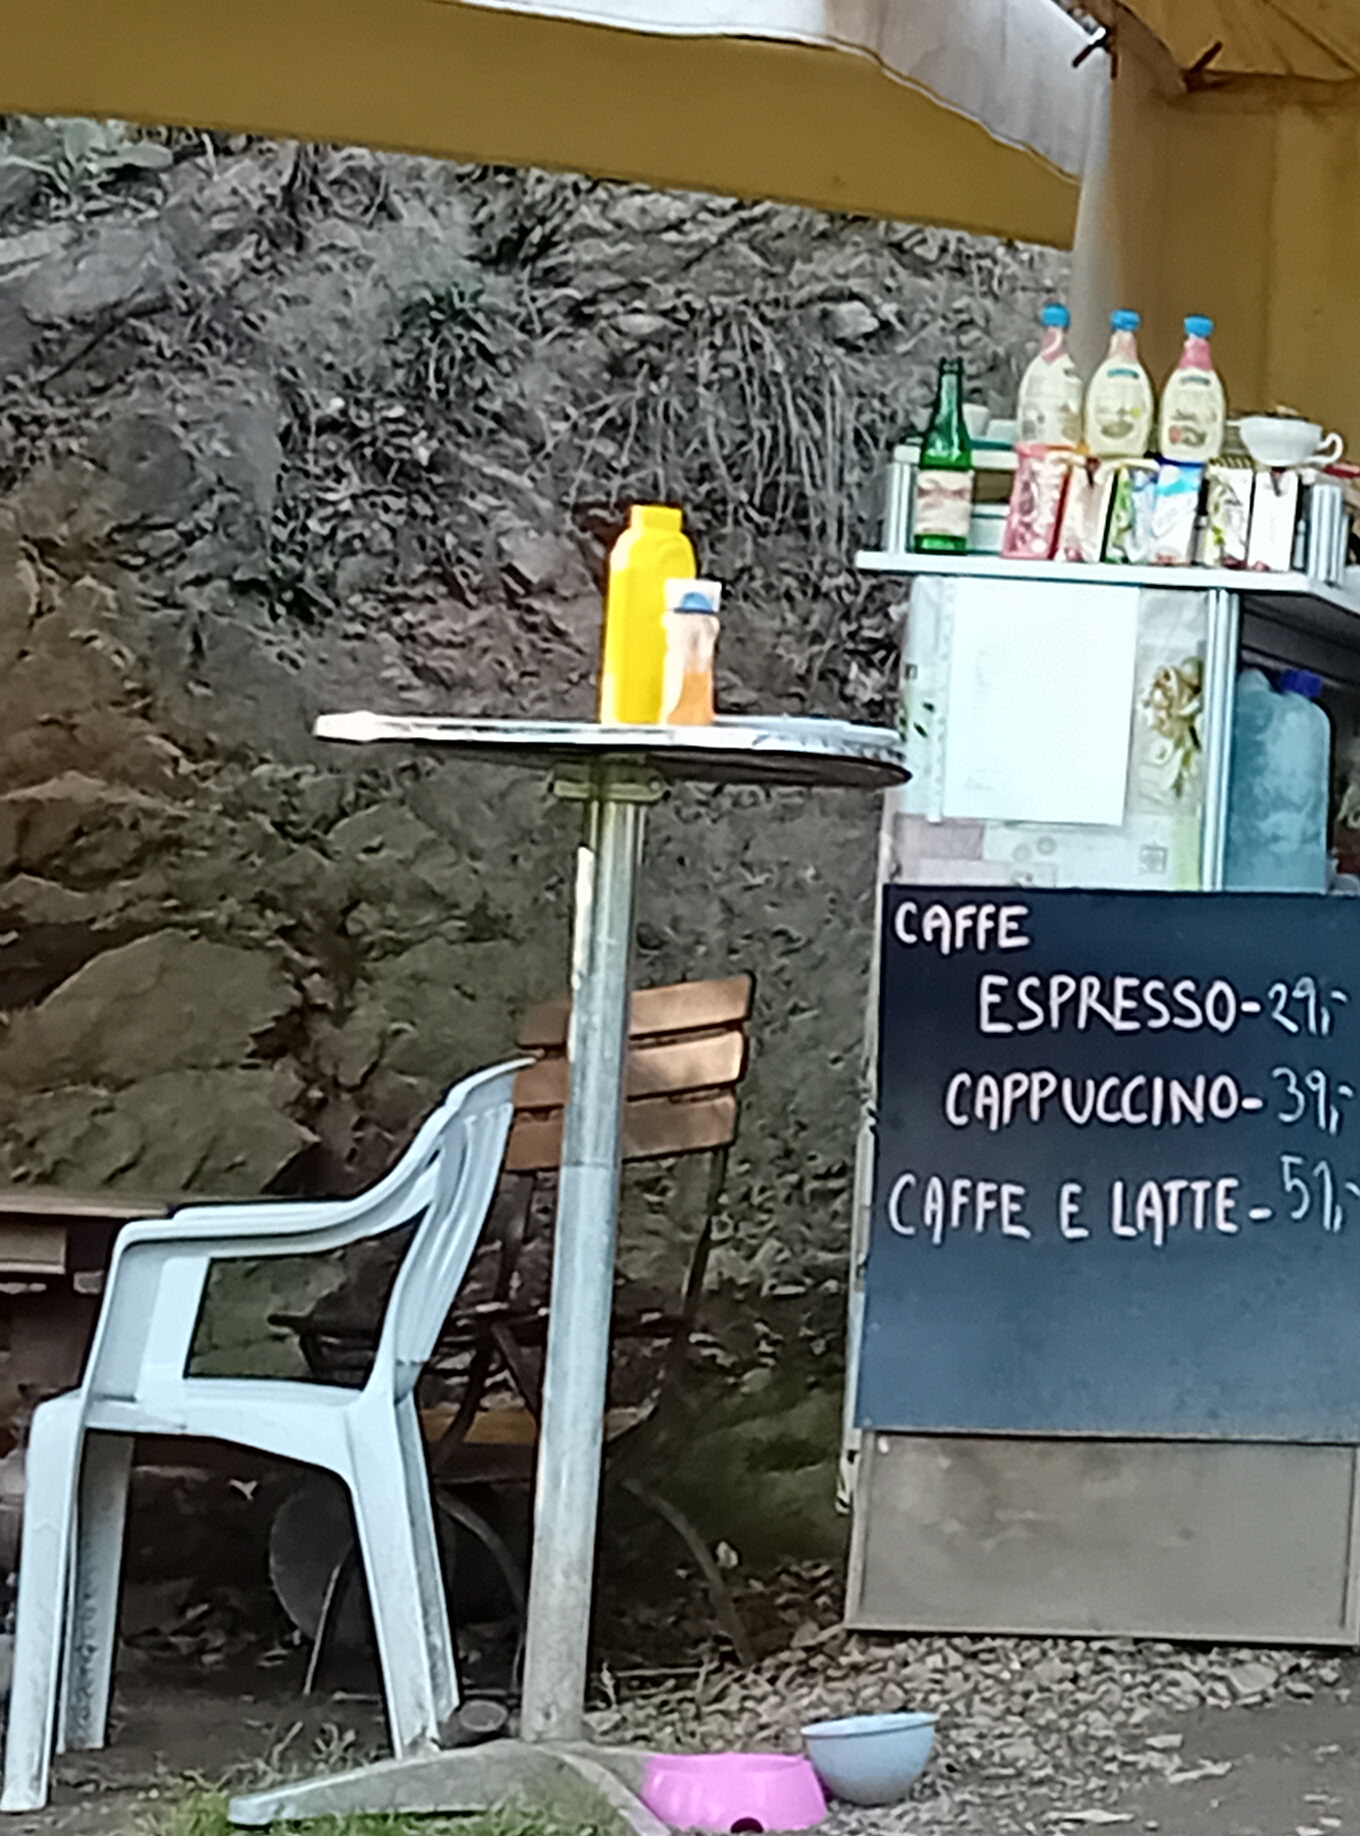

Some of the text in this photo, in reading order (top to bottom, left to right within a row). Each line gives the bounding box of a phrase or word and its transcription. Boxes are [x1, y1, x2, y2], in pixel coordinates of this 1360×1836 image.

[894, 902, 1031, 955] CAFFE
[888, 1173, 1031, 1244] CAFFE
[1059, 1183, 1090, 1239] E
